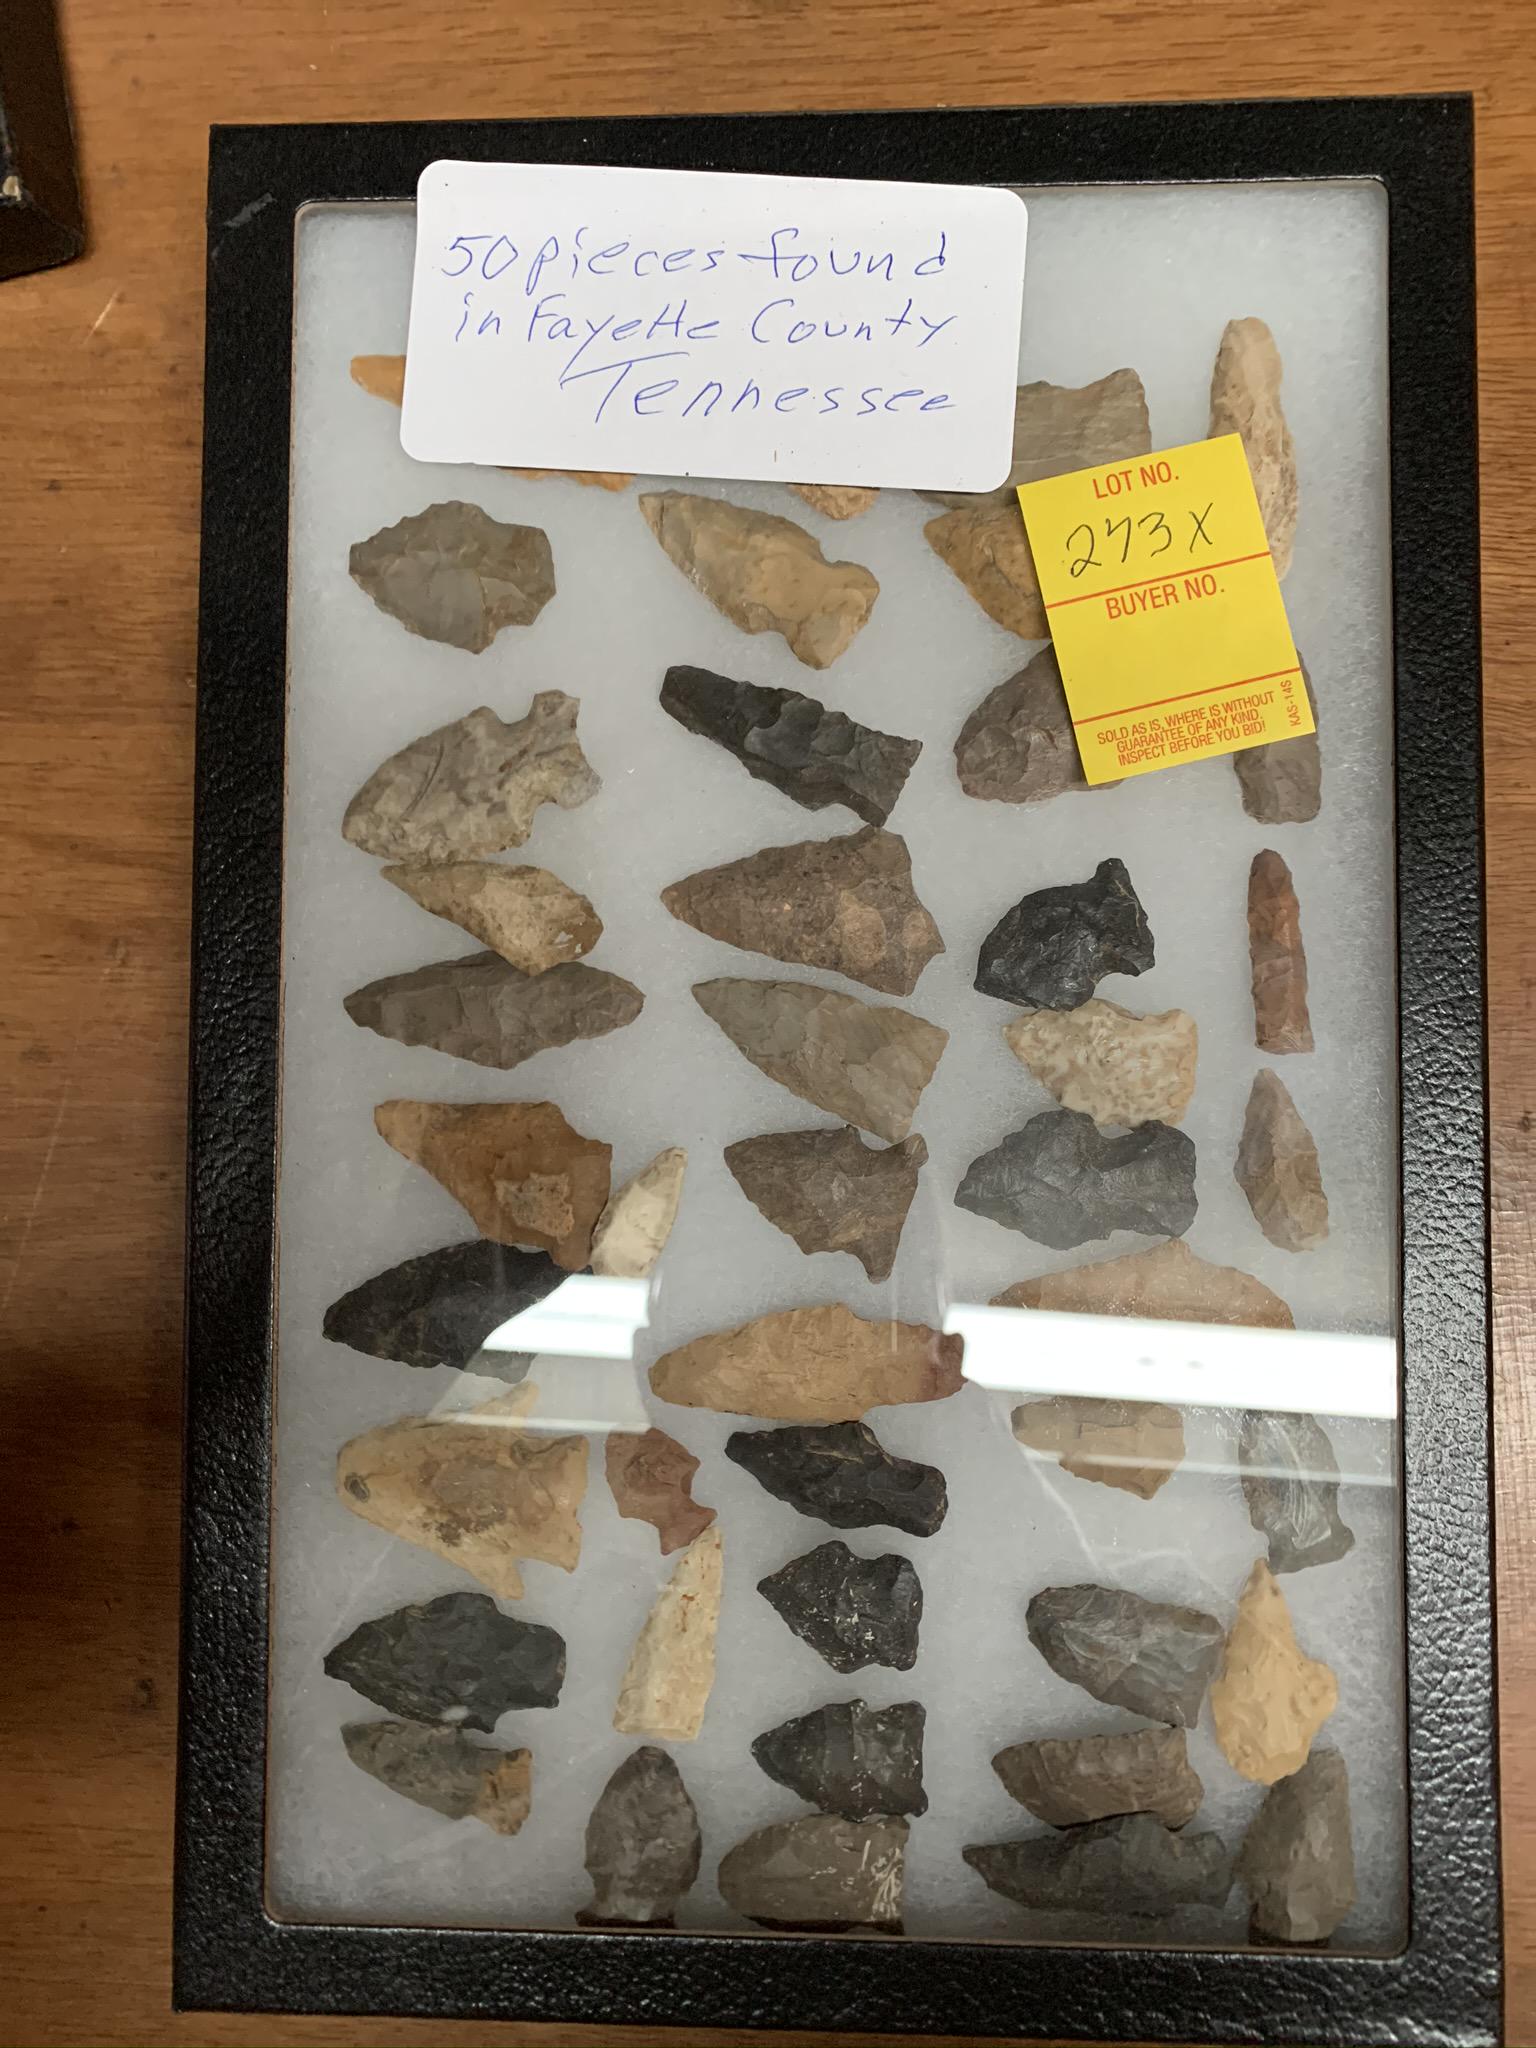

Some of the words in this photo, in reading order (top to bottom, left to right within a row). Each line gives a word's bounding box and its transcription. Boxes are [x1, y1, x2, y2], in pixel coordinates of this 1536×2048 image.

[441, 234, 518, 280] 50
[526, 227, 726, 293] pieces
[738, 227, 947, 281] found
[454, 293, 502, 344] in
[751, 299, 959, 348] County
[560, 352, 957, 423] Tennessee
[1092, 470, 1133, 499] LOT
[1140, 461, 1180, 488] NO.
[1105, 583, 1180, 620] BUYER
[1184, 573, 1225, 603] NO.
[1097, 726, 1129, 745] SOLD
[1131, 723, 1147, 738] AS
[1149, 718, 1164, 732] IS,
[1164, 707, 1206, 728] WHERE
[1209, 704, 1221, 718] IS
[1221, 690, 1275, 714] WITHOUT
[1280, 679, 1301, 728] KAS-14S
[1116, 724, 1185, 753] GUARANTEE
[1187, 720, 1202, 735] OF
[1206, 716, 1228, 733] ANY
[1231, 708, 1263, 727] KIND.
[1118, 743, 1166, 767] INSPECT
[1170, 732, 1215, 754] BEFORE
[1217, 727, 1240, 744] YOU
[1243, 720, 1266, 736] BID!
